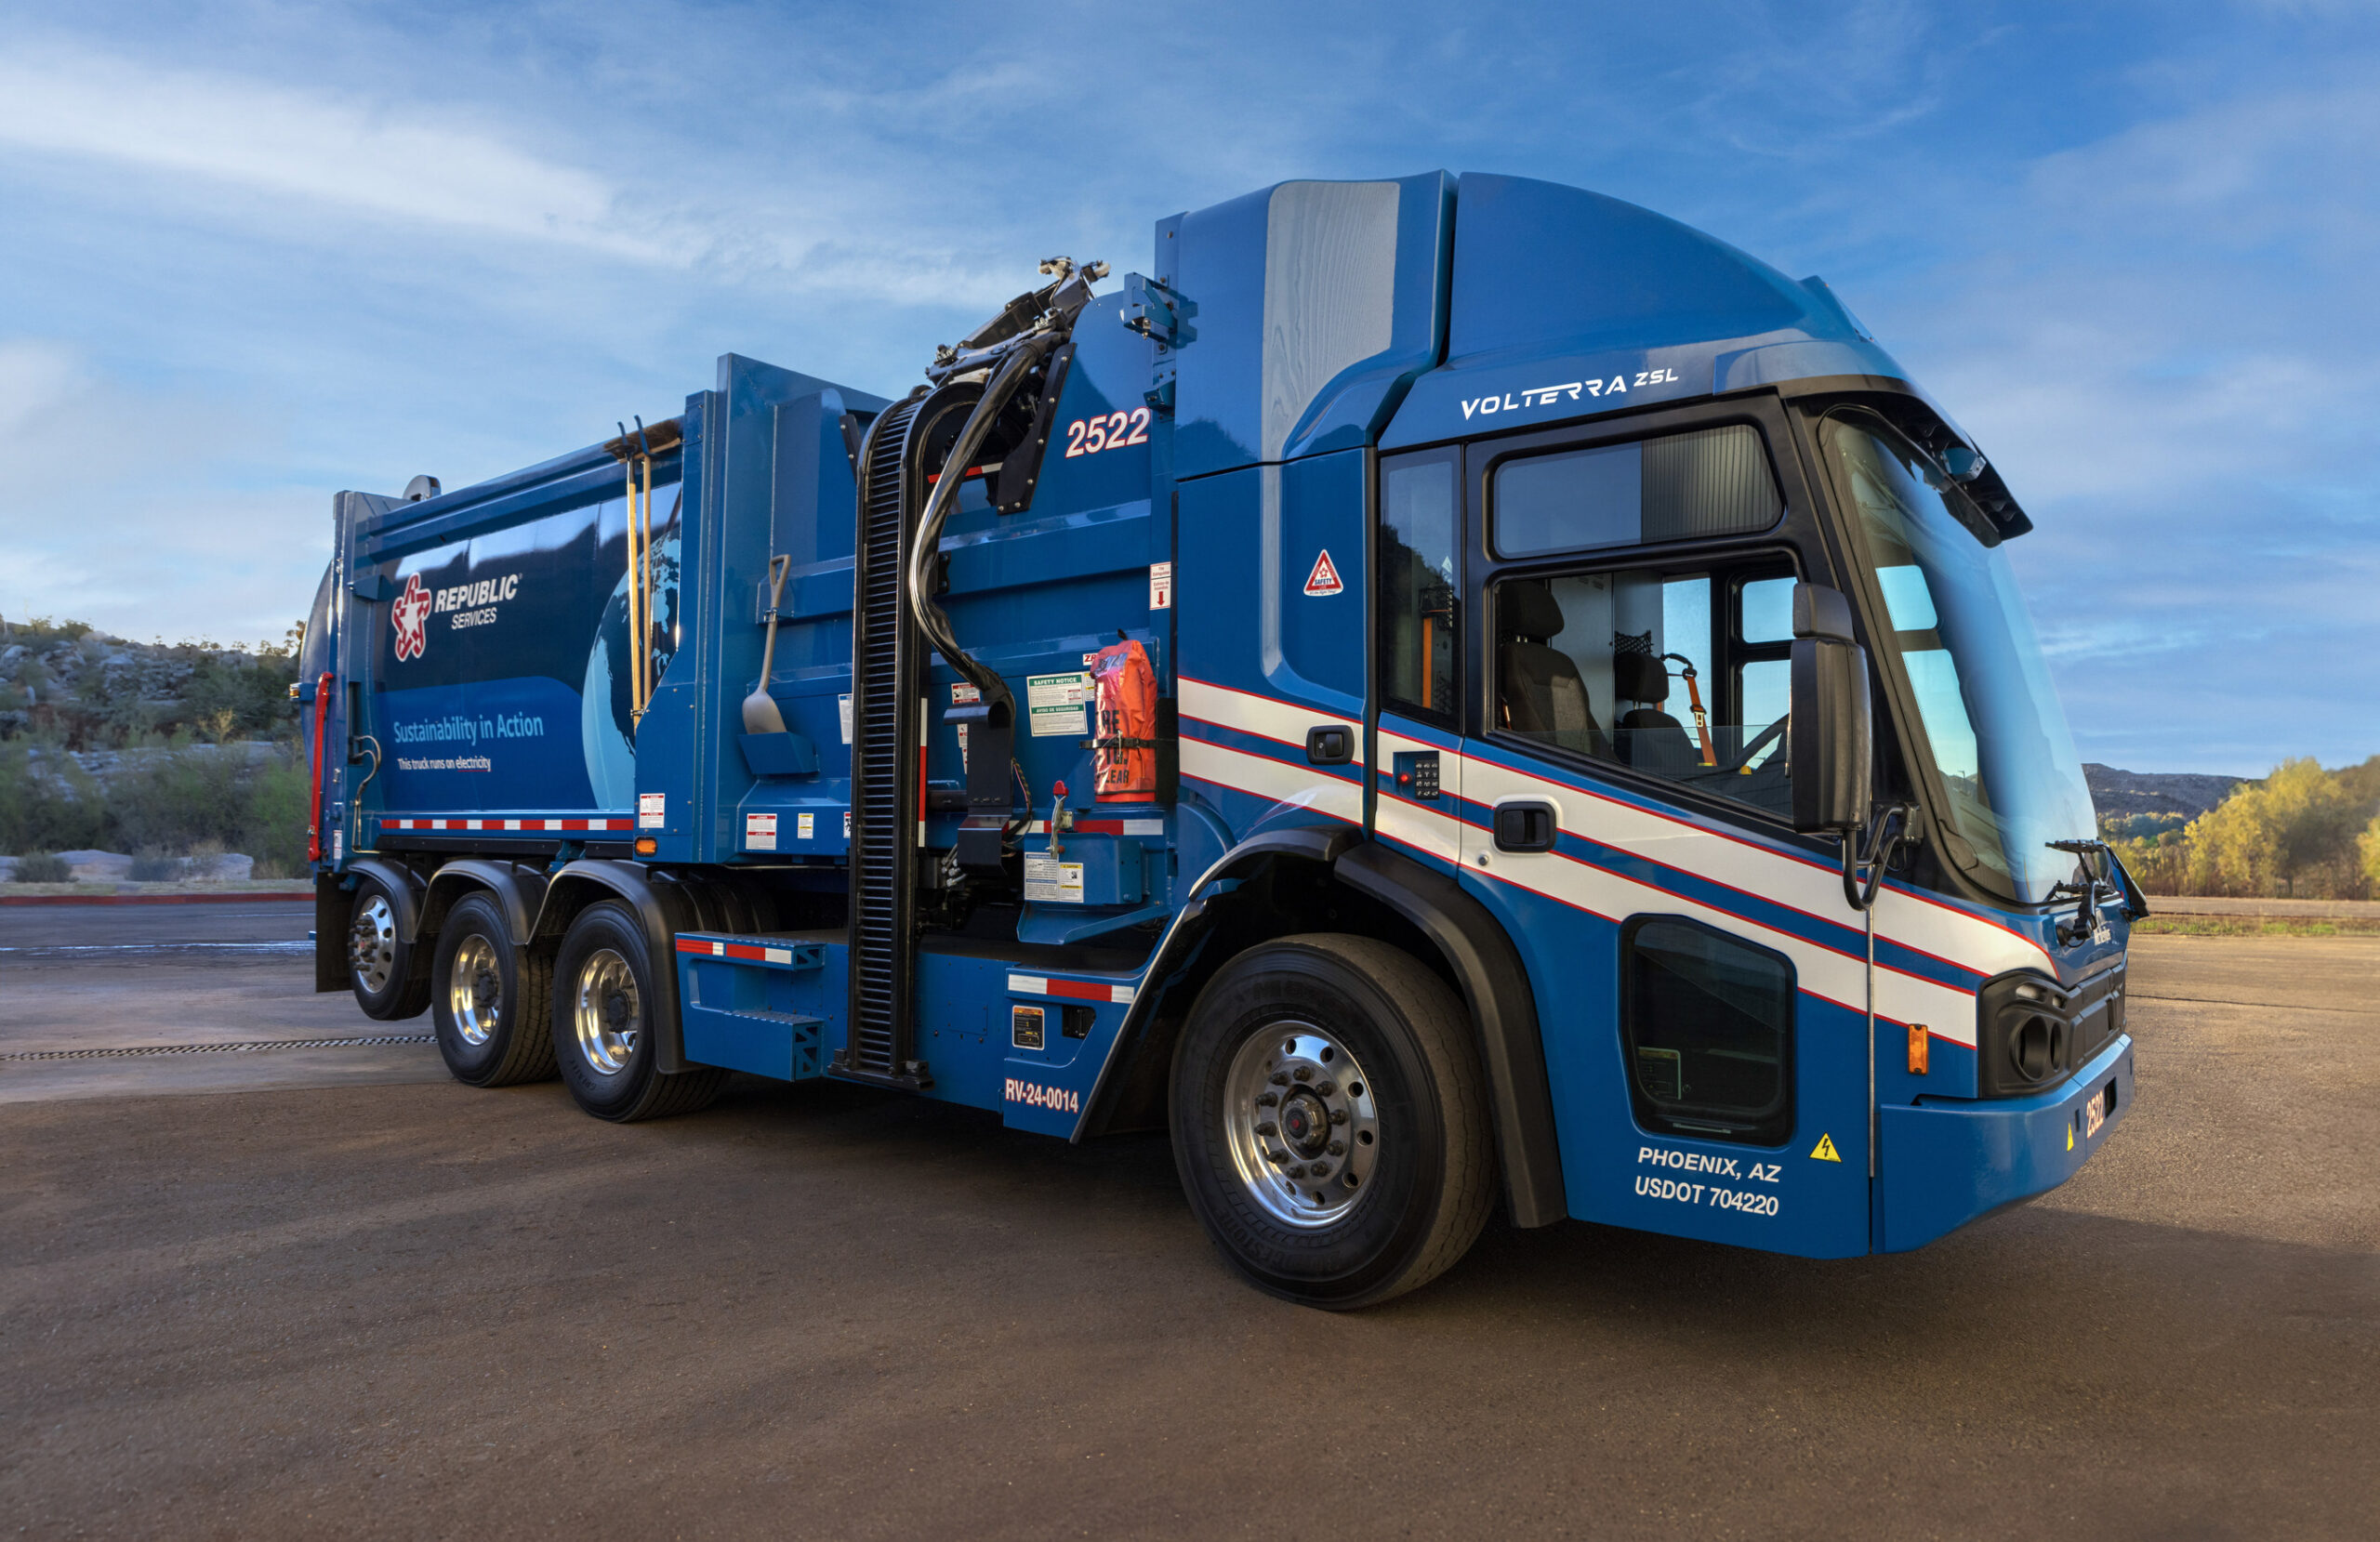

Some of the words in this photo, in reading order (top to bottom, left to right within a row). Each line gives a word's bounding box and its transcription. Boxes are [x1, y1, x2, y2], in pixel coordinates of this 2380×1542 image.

[1461, 375, 1627, 420] VOLTERRA
[1633, 368, 1679, 387] ZSL
[1065, 406, 1151, 458] 2522
[434, 573, 519, 613] REPUBLIC
[451, 607, 497, 630] SERVICES
[393, 716, 477, 746] Sustainability
[479, 714, 494, 739] in
[496, 711, 544, 738] Action
[397, 758, 412, 771] This
[412, 757, 430, 771] truck
[430, 758, 446, 770] runs
[446, 758, 456, 770] on
[456, 755, 491, 772] electricity
[1005, 1077, 1078, 1114] RV-24-0014
[2086, 1089, 2105, 1140] 2522
[1637, 1146, 1742, 1180] PHOENIX,
[1748, 1163, 1782, 1183] AZ
[1634, 1175, 1705, 1205] USDOT
[1709, 1187, 1779, 1217] 704220
